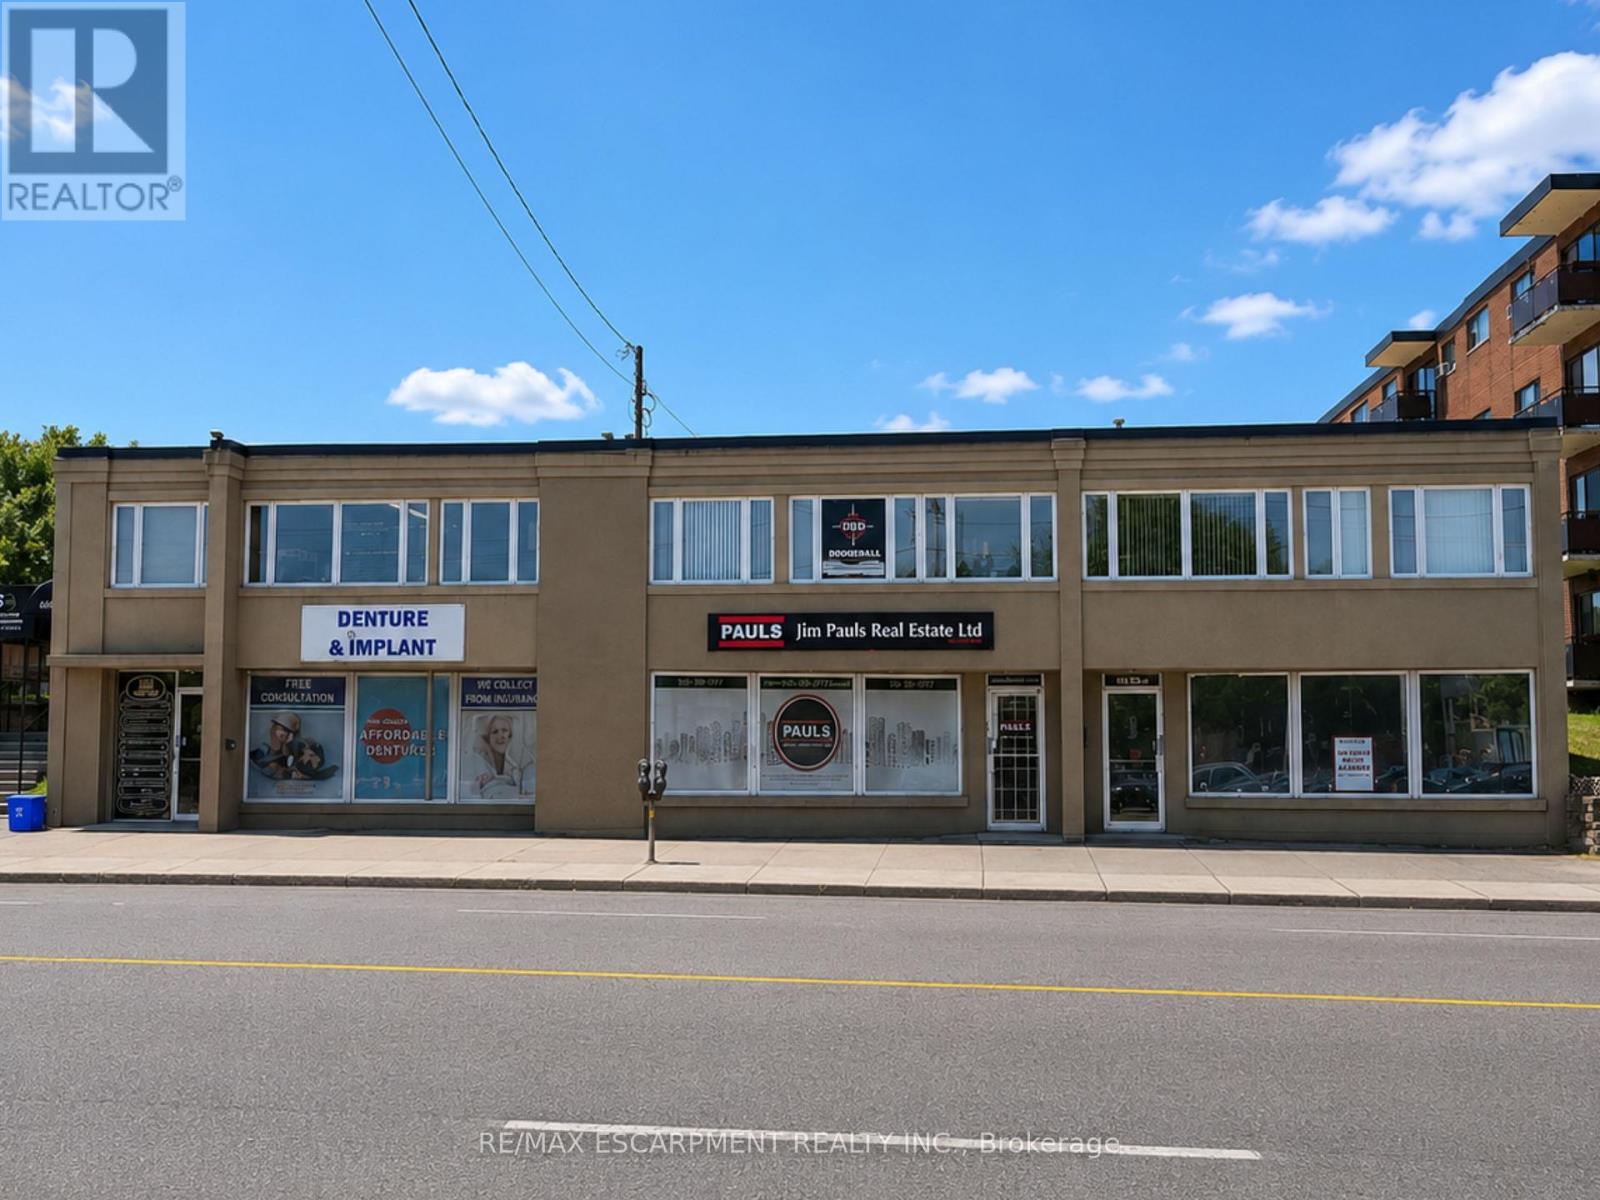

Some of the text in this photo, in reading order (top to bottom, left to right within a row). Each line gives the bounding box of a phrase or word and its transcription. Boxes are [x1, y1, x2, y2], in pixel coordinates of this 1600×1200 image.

[338, 610, 429, 628] DENTURE
[721, 624, 783, 640] PAULS
[796, 622, 983, 641] Jim Pauls Real Estate Ltd
[329, 639, 437, 656] & IMPLANT
[285, 678, 312, 689] FREE
[494, 680, 533, 690] COLLECT
[360, 729, 447, 741] AFFORDABE
[783, 724, 831, 738] PAULS
